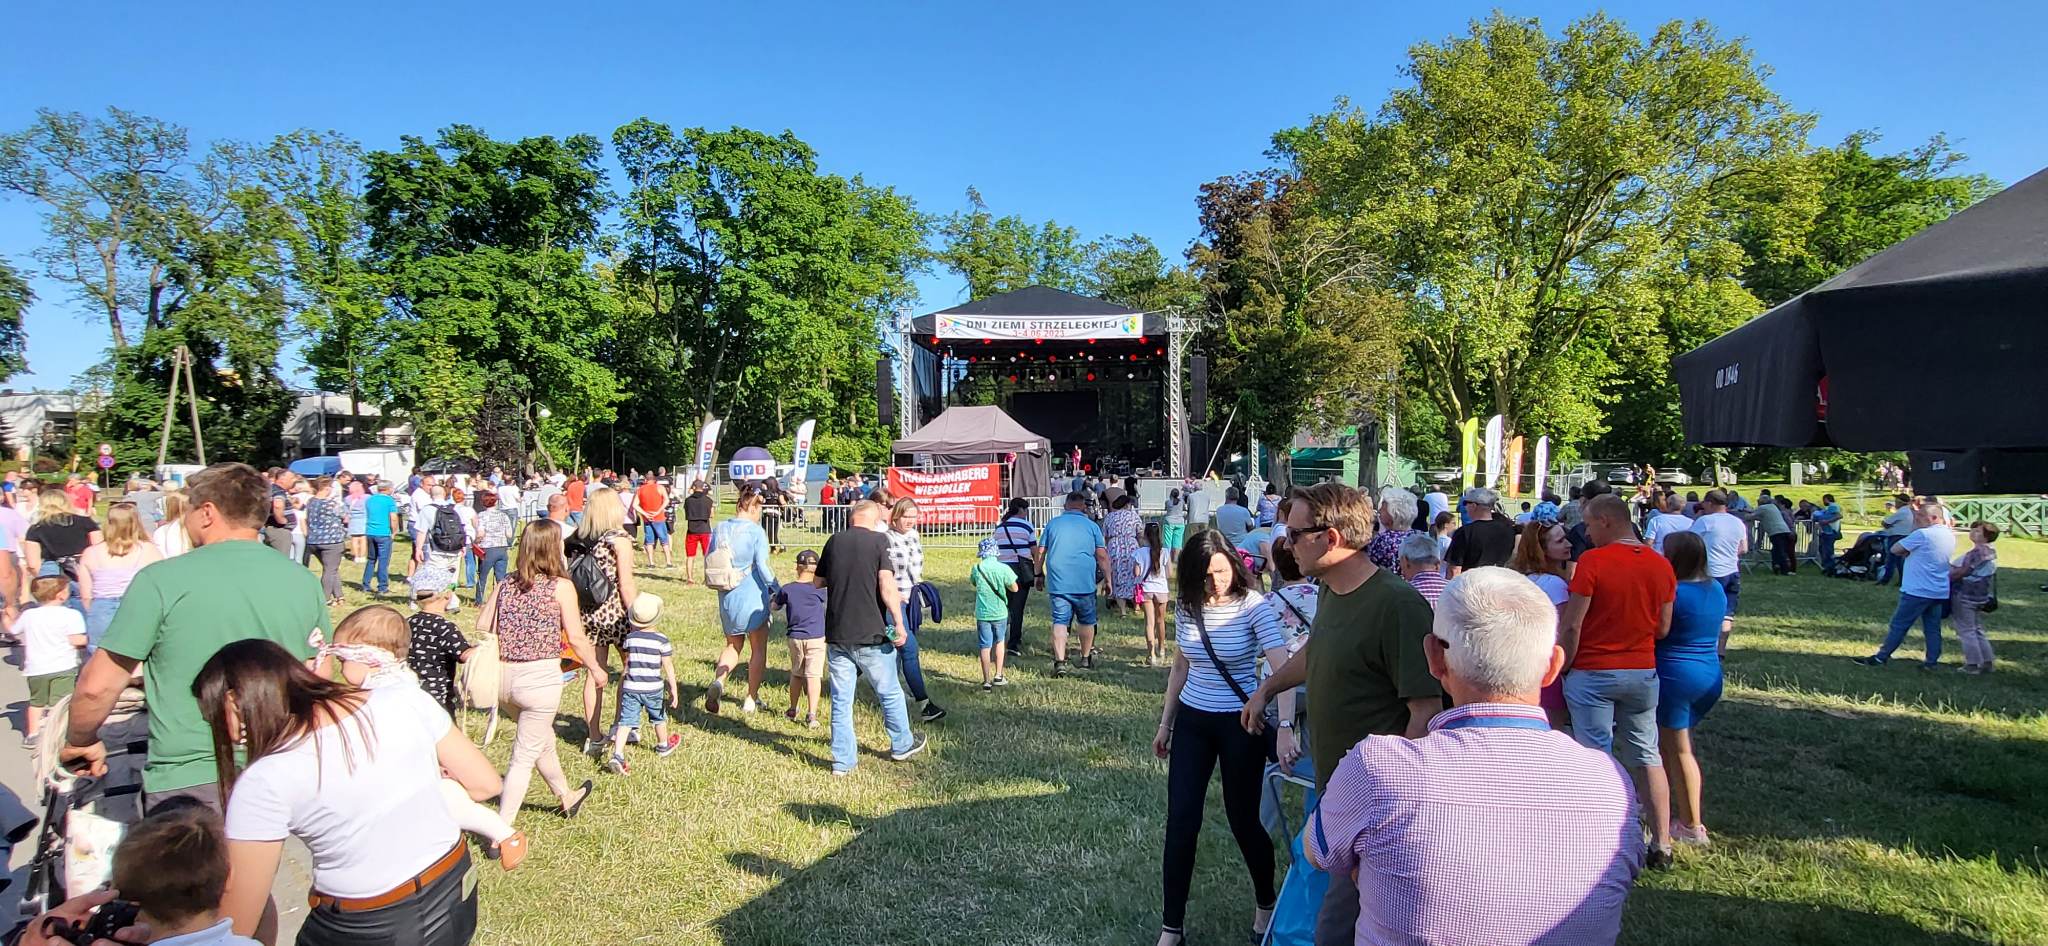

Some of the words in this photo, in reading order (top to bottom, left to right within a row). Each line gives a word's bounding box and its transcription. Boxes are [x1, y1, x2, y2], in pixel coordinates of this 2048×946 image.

[966, 321, 987, 329] DNI
[991, 321, 1026, 330] ZIEMI
[1030, 320, 1118, 330] STRZELECKIEJ
[734, 465, 764, 475] TVS
[899, 467, 989, 483] TRANSANNABERG
